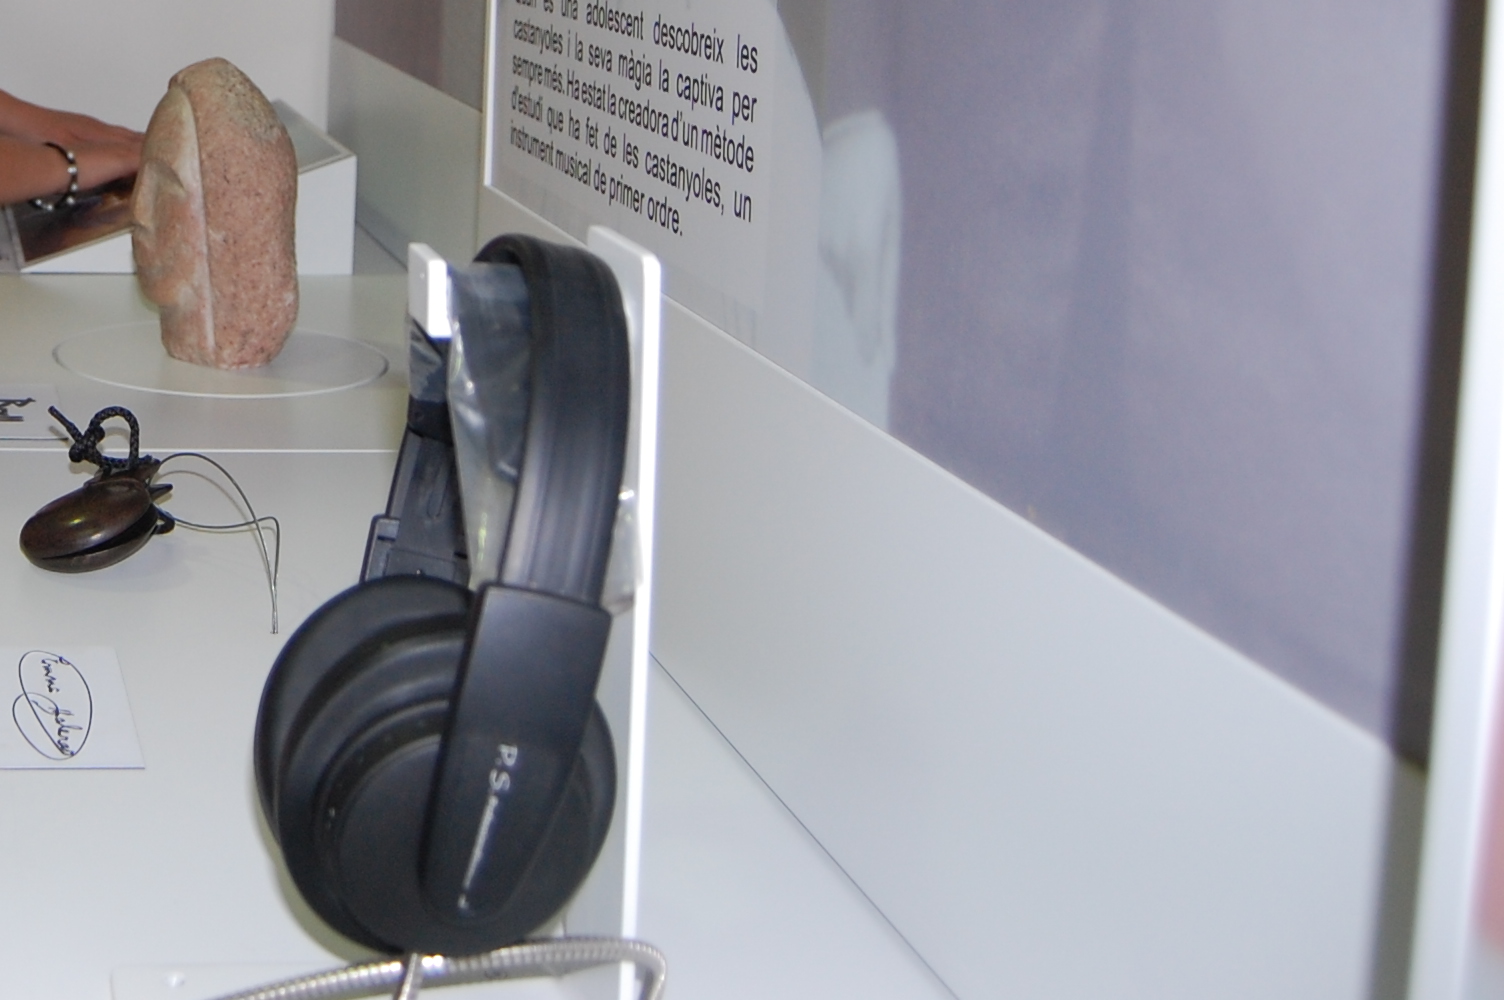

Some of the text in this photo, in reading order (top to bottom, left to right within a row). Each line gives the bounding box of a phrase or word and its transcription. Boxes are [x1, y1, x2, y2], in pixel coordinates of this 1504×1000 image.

[513, 18, 757, 125] castanyoles i la seva màgia la captiva per
[653, 13, 725, 64] descobreix
[736, 34, 758, 74] les
[512, 54, 543, 87] sempre
[567, 69, 580, 101] Ha
[581, 77, 606, 112] estat
[607, 84, 616, 116] la
[618, 96, 669, 138] creadora
[701, 125, 754, 173] mètode
[547, 106, 564, 134] que
[568, 109, 580, 140] ha
[585, 117, 599, 149] fet
[604, 126, 617, 158] de
[622, 133, 639, 169] les
[645, 150, 724, 215] castanyoles,
[734, 190, 752, 223] un
[510, 120, 683, 237] instrument musical de primer ordre.
